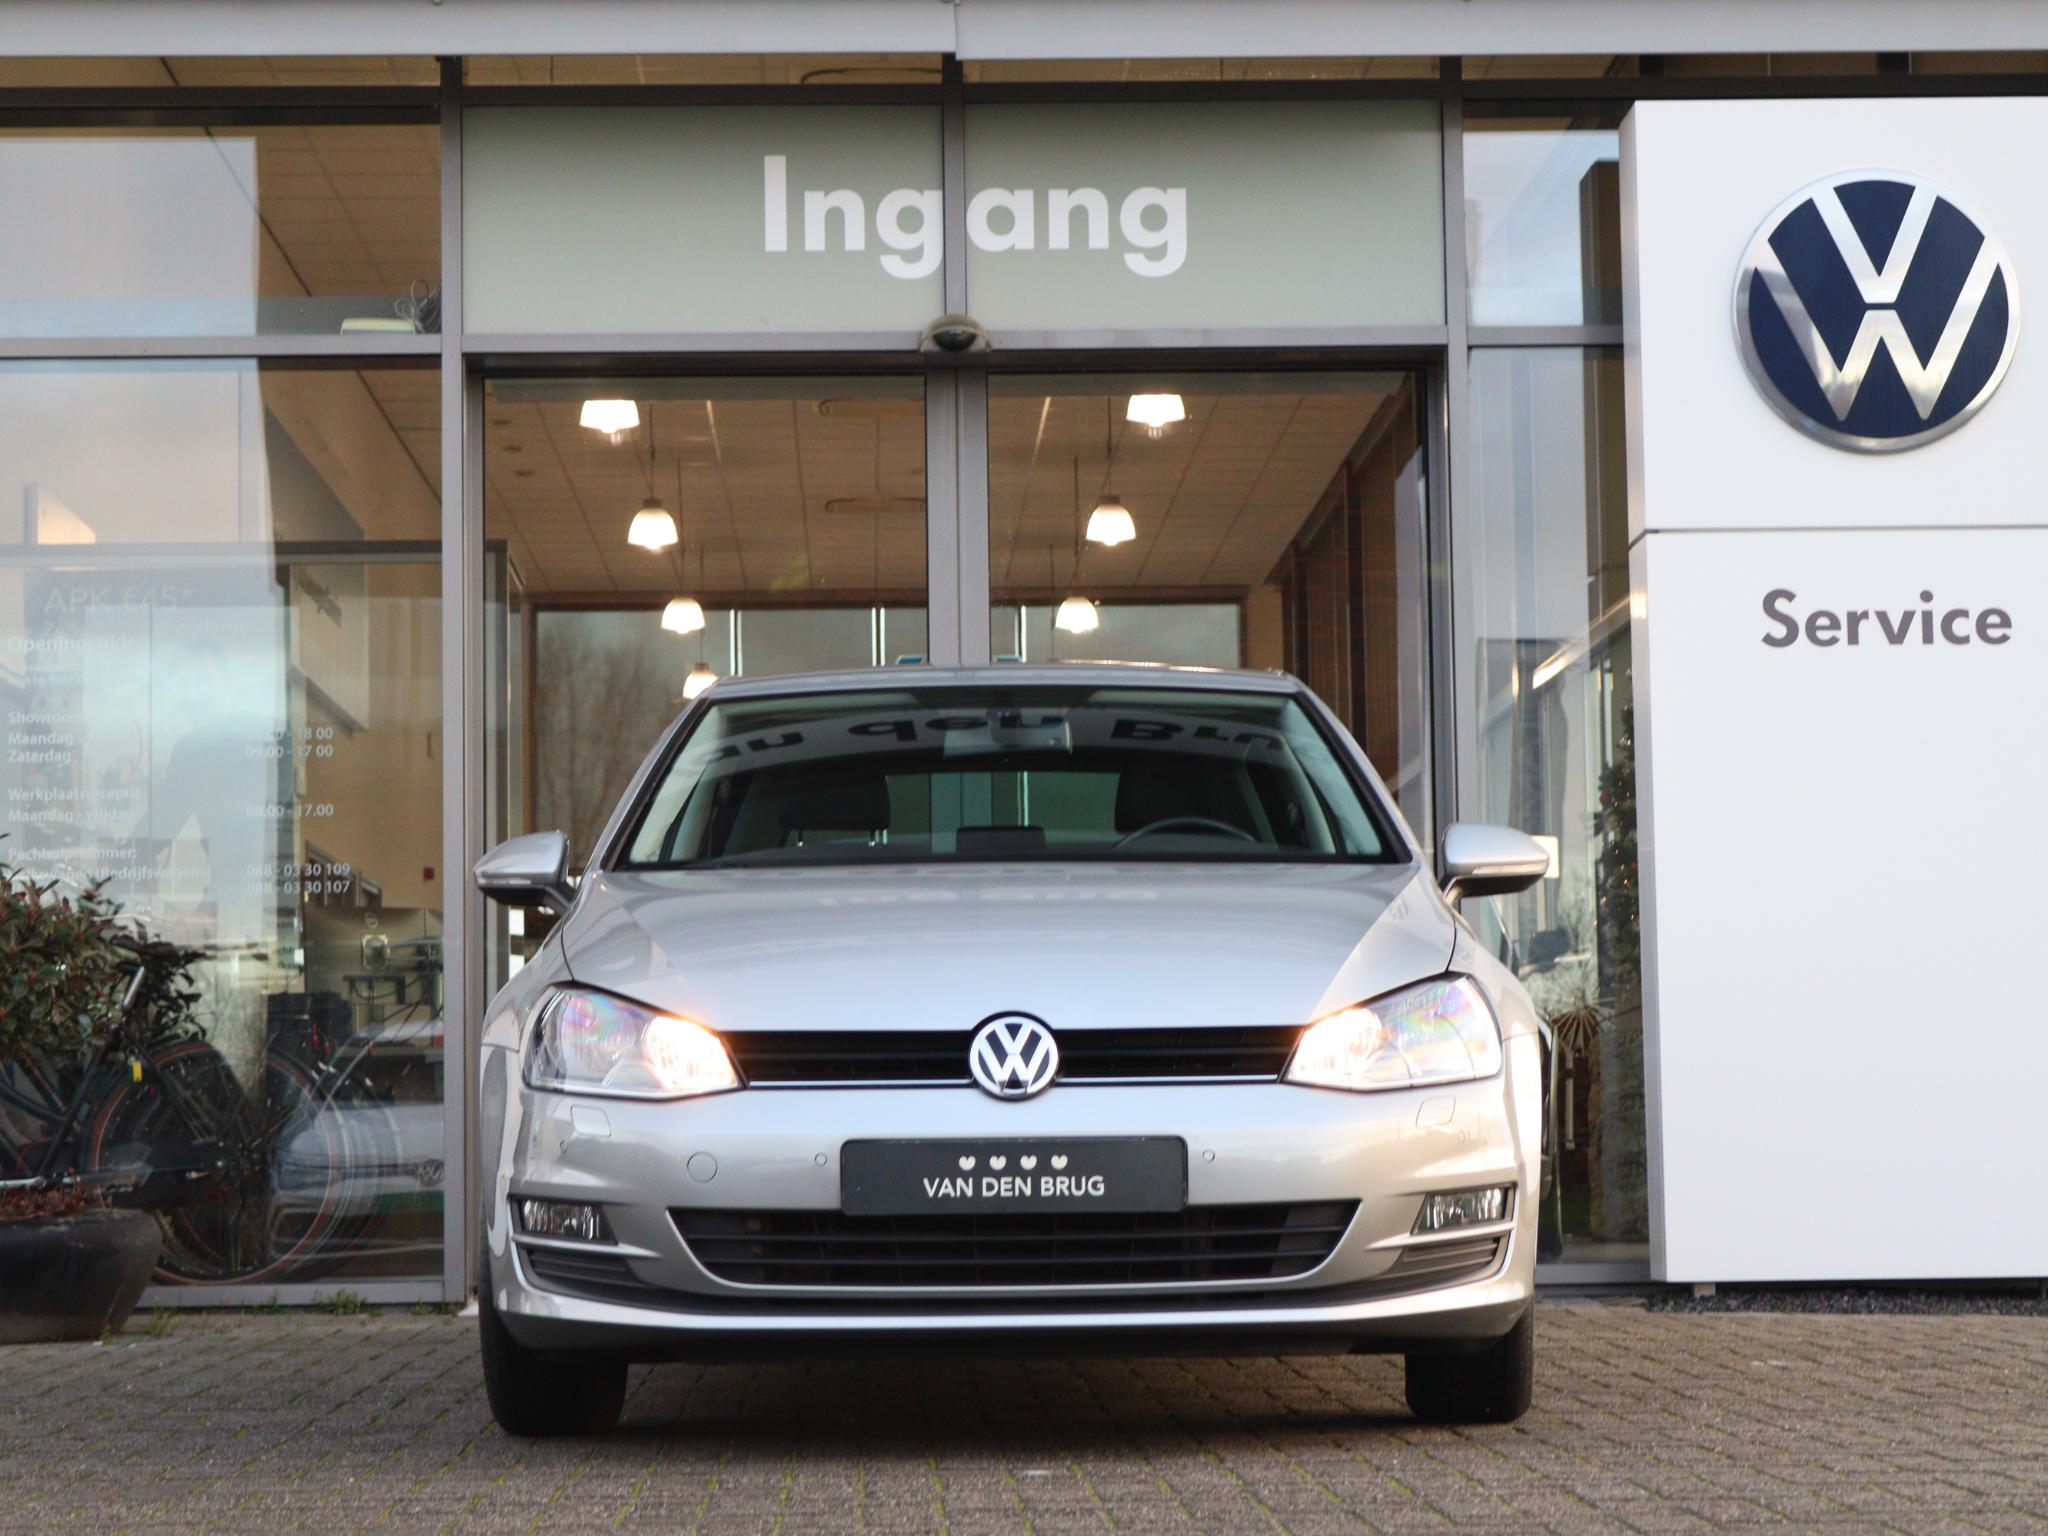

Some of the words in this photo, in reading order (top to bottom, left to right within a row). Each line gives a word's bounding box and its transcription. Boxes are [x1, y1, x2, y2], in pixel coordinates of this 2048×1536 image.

[763, 154, 1187, 279] Ingang
[1760, 588, 2013, 648] Service
[923, 1177, 973, 1199] VAN
[981, 1177, 1032, 1198] DEN
[1040, 1175, 1105, 1198] BRUG
